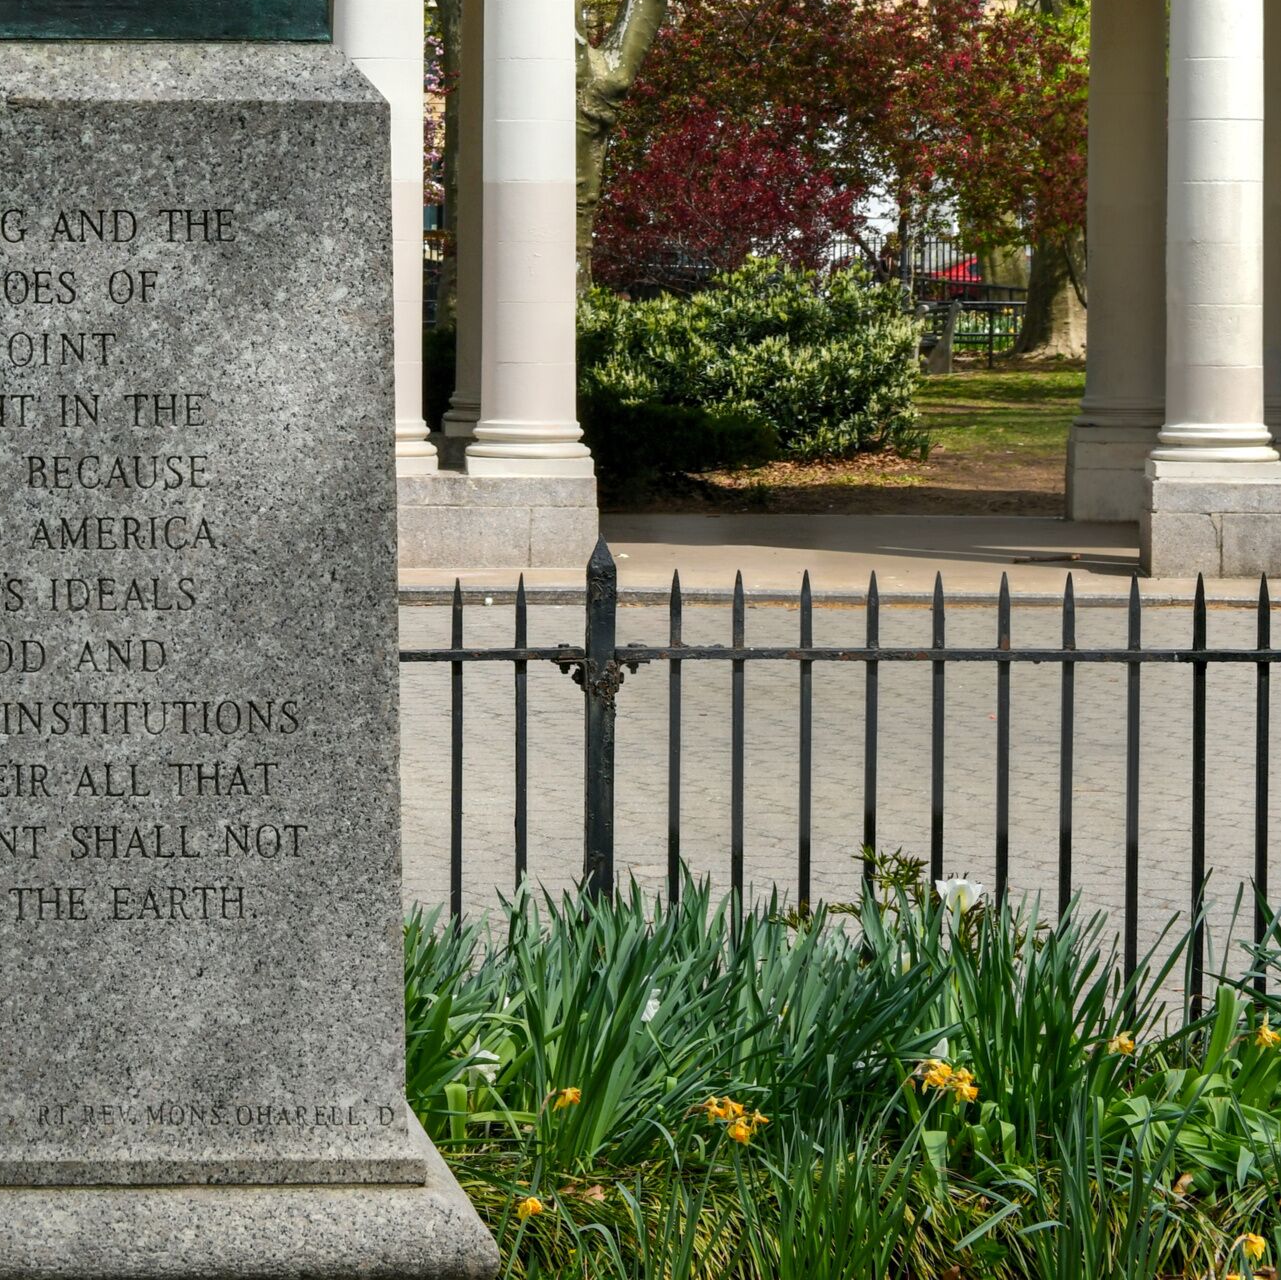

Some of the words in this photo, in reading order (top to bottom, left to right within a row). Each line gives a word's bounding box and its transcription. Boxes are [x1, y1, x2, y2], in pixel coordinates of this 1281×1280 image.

[51, 209, 137, 243] AND
[159, 209, 236, 242] THE
[109, 269, 158, 304] OF
[60, 393, 100, 428] IN
[125, 393, 205, 427] THE
[26, 455, 209, 490] BECAUSE
[29, 516, 218, 551] AMERICA
[50, 577, 197, 613] IDEALS
[74, 640, 167, 674] AND
[2, 700, 300, 736] INSTITUTIONS
[72, 763, 151, 797] ALL
[171, 762, 278, 797] THAT
[70, 825, 201, 860] SHALL
[223, 824, 308, 859] NOT
[8, 888, 88, 922] THE
[146, 1105, 230, 1126] MONS.
